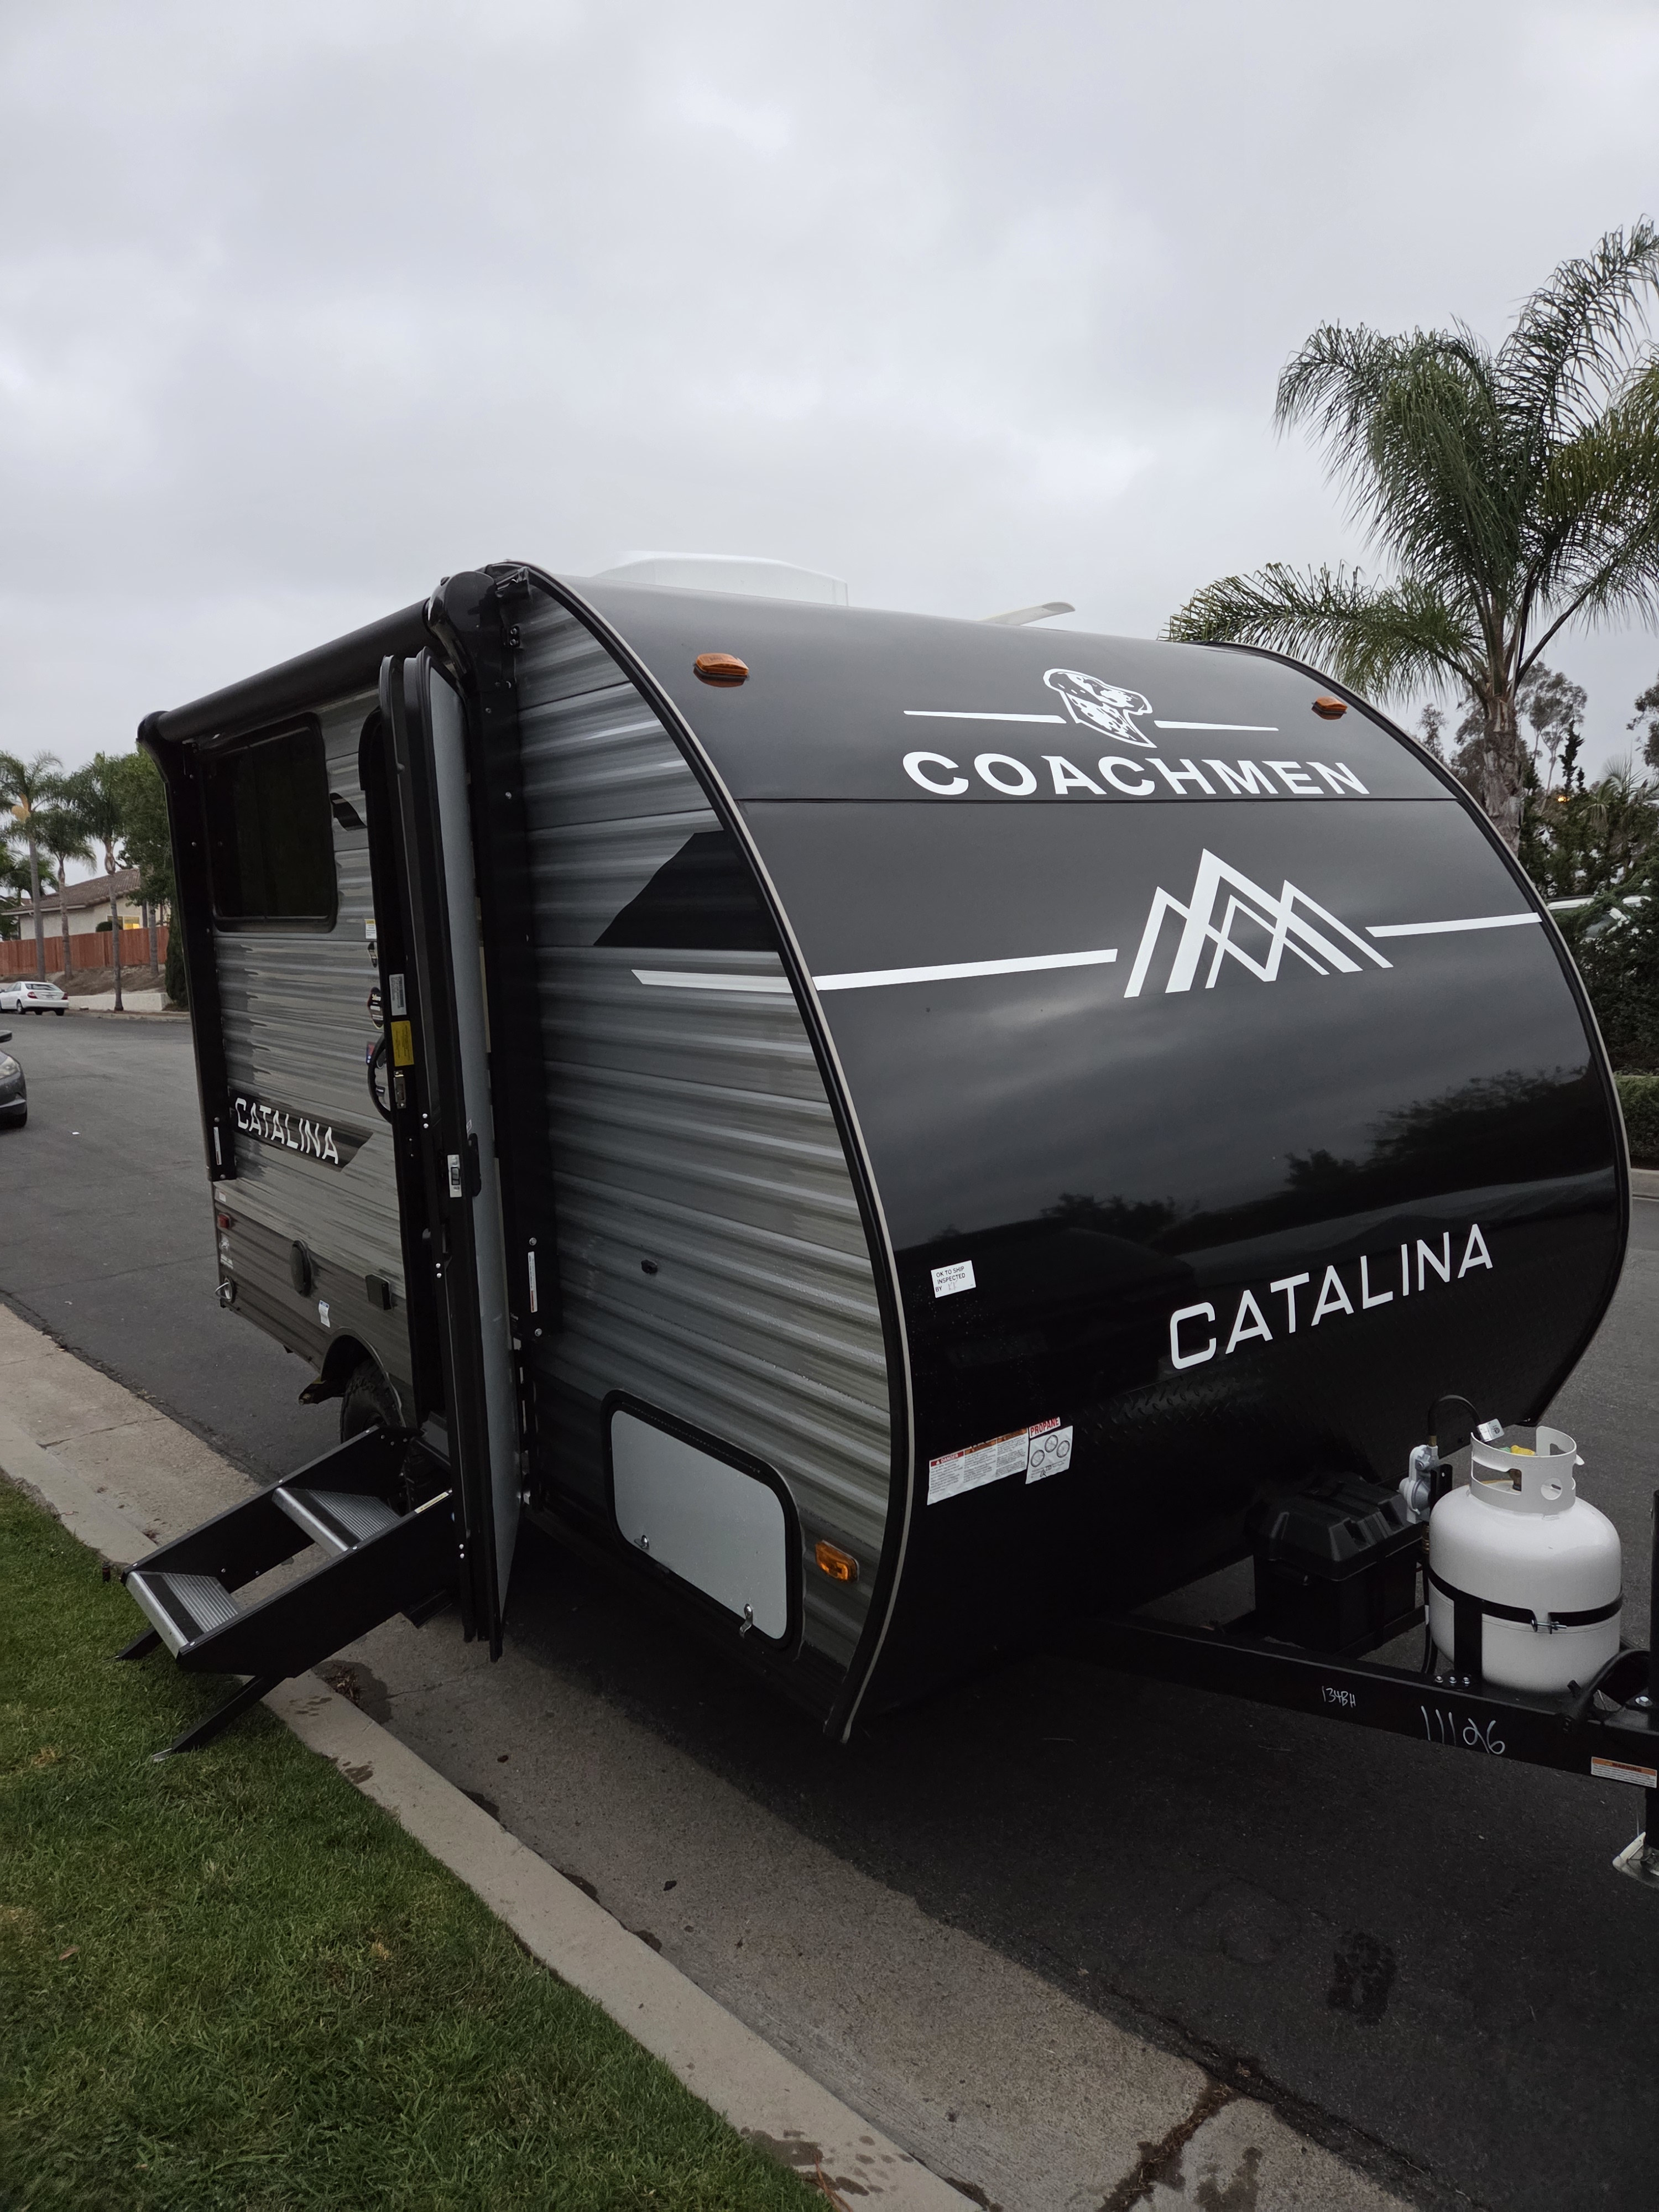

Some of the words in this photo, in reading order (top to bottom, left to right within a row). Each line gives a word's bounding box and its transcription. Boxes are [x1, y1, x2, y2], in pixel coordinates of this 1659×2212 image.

[902, 752, 1370, 796] COACHMEN
[235, 1098, 339, 1165] CATALINA
[937, 1273, 966, 1284] INSPECTED
[1170, 1224, 1493, 1370] CATALINA
[1030, 1418, 1059, 1436] PROPANE
[1322, 1686, 1356, 1708] 134BH
